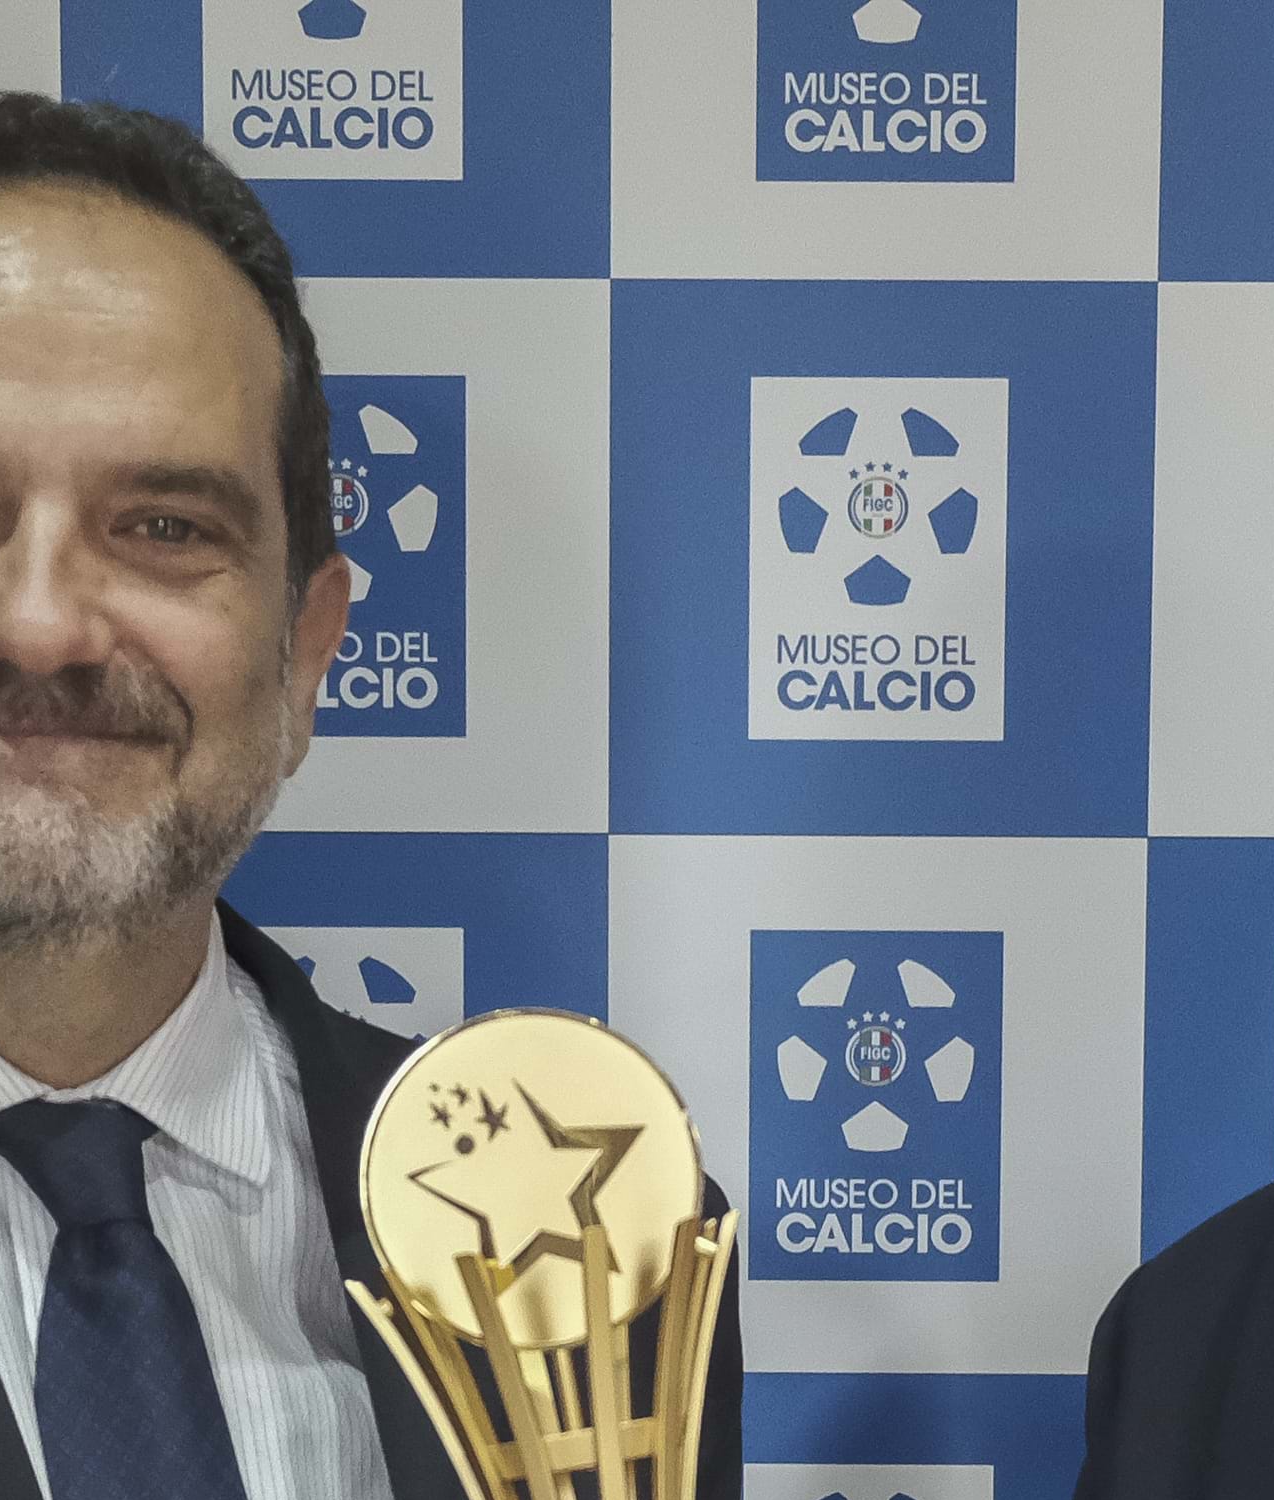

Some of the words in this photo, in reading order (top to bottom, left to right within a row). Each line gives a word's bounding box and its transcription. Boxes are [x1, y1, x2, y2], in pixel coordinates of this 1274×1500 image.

[231, 69, 358, 101] MUSEO
[371, 70, 434, 101] DEL
[784, 72, 911, 105] MUSEO
[924, 73, 987, 105] DEL
[232, 106, 434, 150] CALCIO
[785, 108, 987, 153] CALCIO
[862, 498, 894, 512] FIGC
[376, 631, 438, 662] DEL
[777, 634, 901, 666] MUSEO
[914, 634, 976, 666] DEL
[316, 666, 438, 709] LCIO
[777, 669, 976, 712] CALCIO
[860, 1046, 891, 1060] FIGC
[776, 1178, 899, 1210] MUSEO
[911, 1178, 973, 1210] DEL
[776, 1212, 973, 1255] CALCIO
